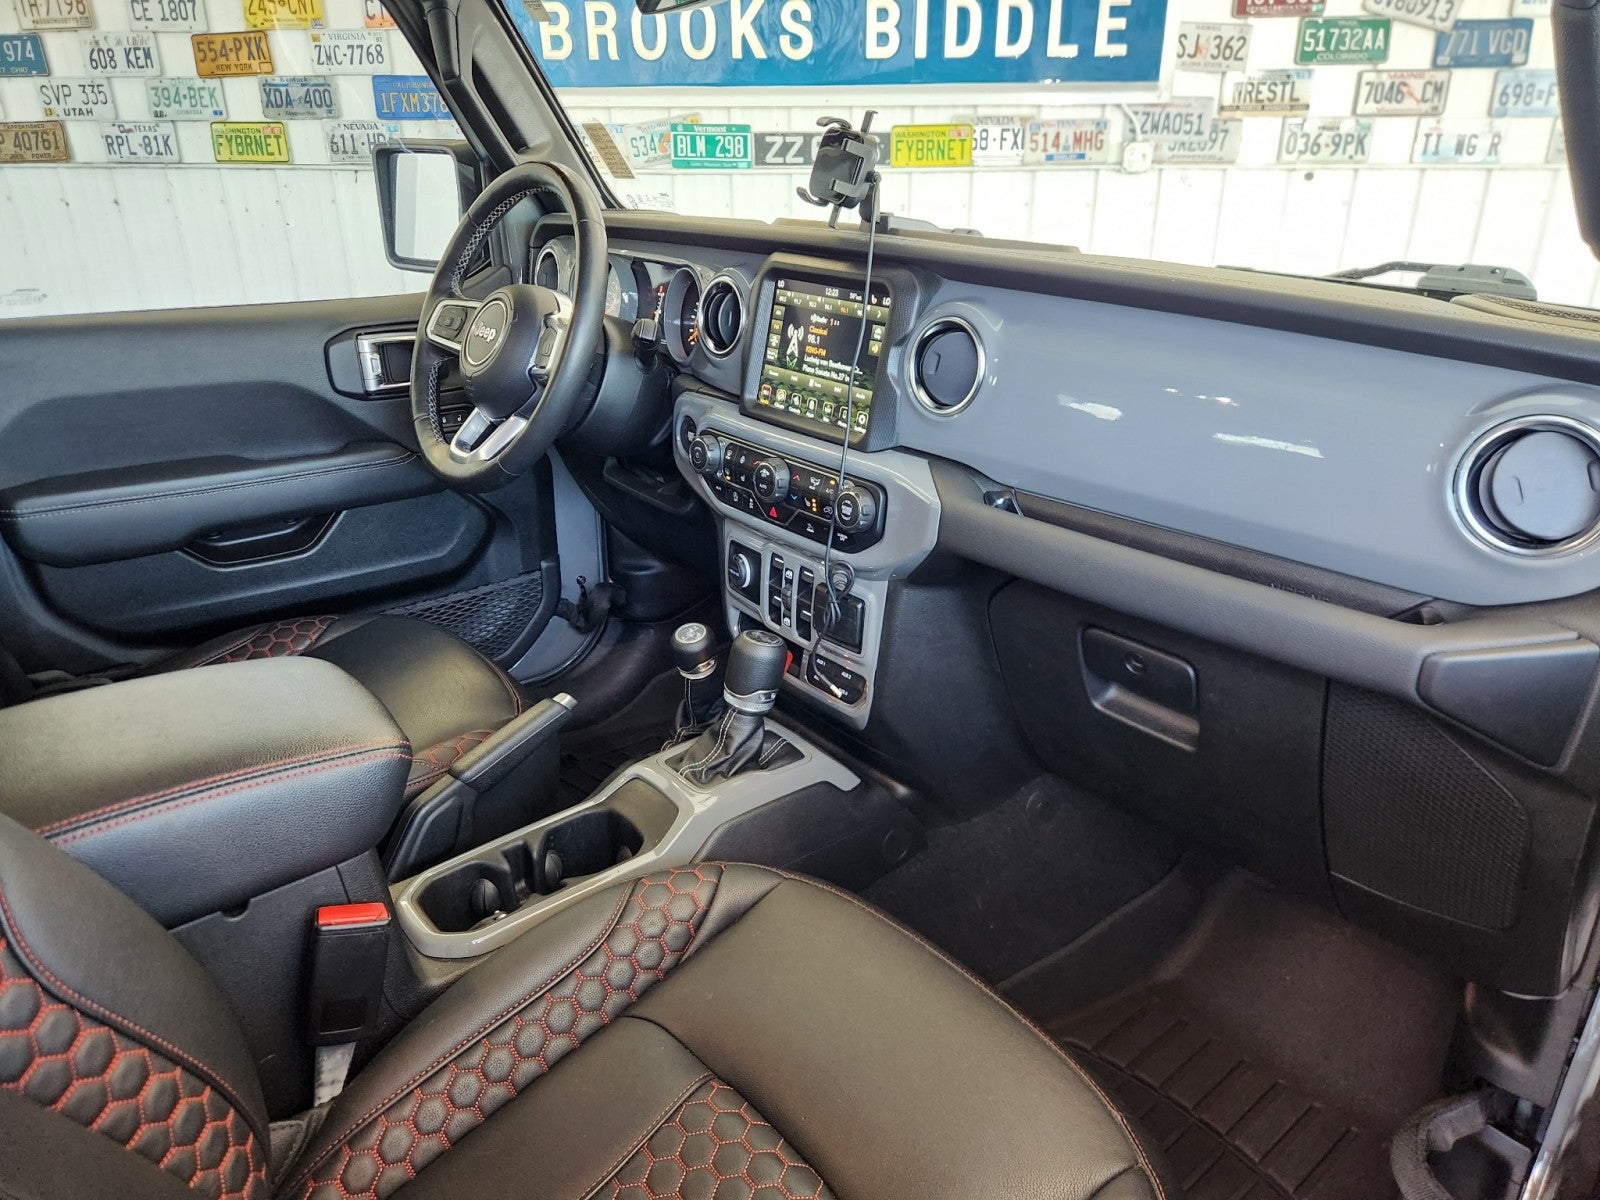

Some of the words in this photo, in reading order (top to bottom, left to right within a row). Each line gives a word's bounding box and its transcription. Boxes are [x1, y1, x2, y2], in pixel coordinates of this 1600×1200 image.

[328, 32, 367, 41] VIRGINIA
[538, 0, 814, 61] BROOKS
[865, 0, 1132, 59] BIDDLE
[1303, 27, 1386, 52] 51732AA
[1176, 33, 1201, 59] SJ
[1210, 34, 1247, 61] 362
[1316, 52, 1368, 61] COLORADO
[89, 47, 118, 70] 608
[215, 64, 233, 72] NEW
[234, 62, 253, 71] YORK
[40, 84, 72, 106] SVP
[78, 84, 108, 105] 335
[1364, 81, 1406, 105] 7046
[1421, 80, 1445, 104] CM
[63, 107, 94, 117] UTAH
[133, 124, 157, 133] TEXAS
[343, 123, 379, 131] NEVADA
[694, 124, 727, 134] Vermont
[894, 131, 947, 139] WASHINGTON
[13, 130, 60, 151] 40761
[105, 134, 137, 156] RPL
[142, 135, 173, 156] 81K
[215, 135, 282, 157] FYBRNET
[715, 135, 744, 158] 298
[765, 136, 804, 164] ZZ
[895, 137, 968, 161] FYBRNET
[1029, 131, 1061, 153] 514
[1072, 130, 1105, 152] MHG
[475, 321, 497, 343] Jeep
[807, 334, 820, 345] 98.1
